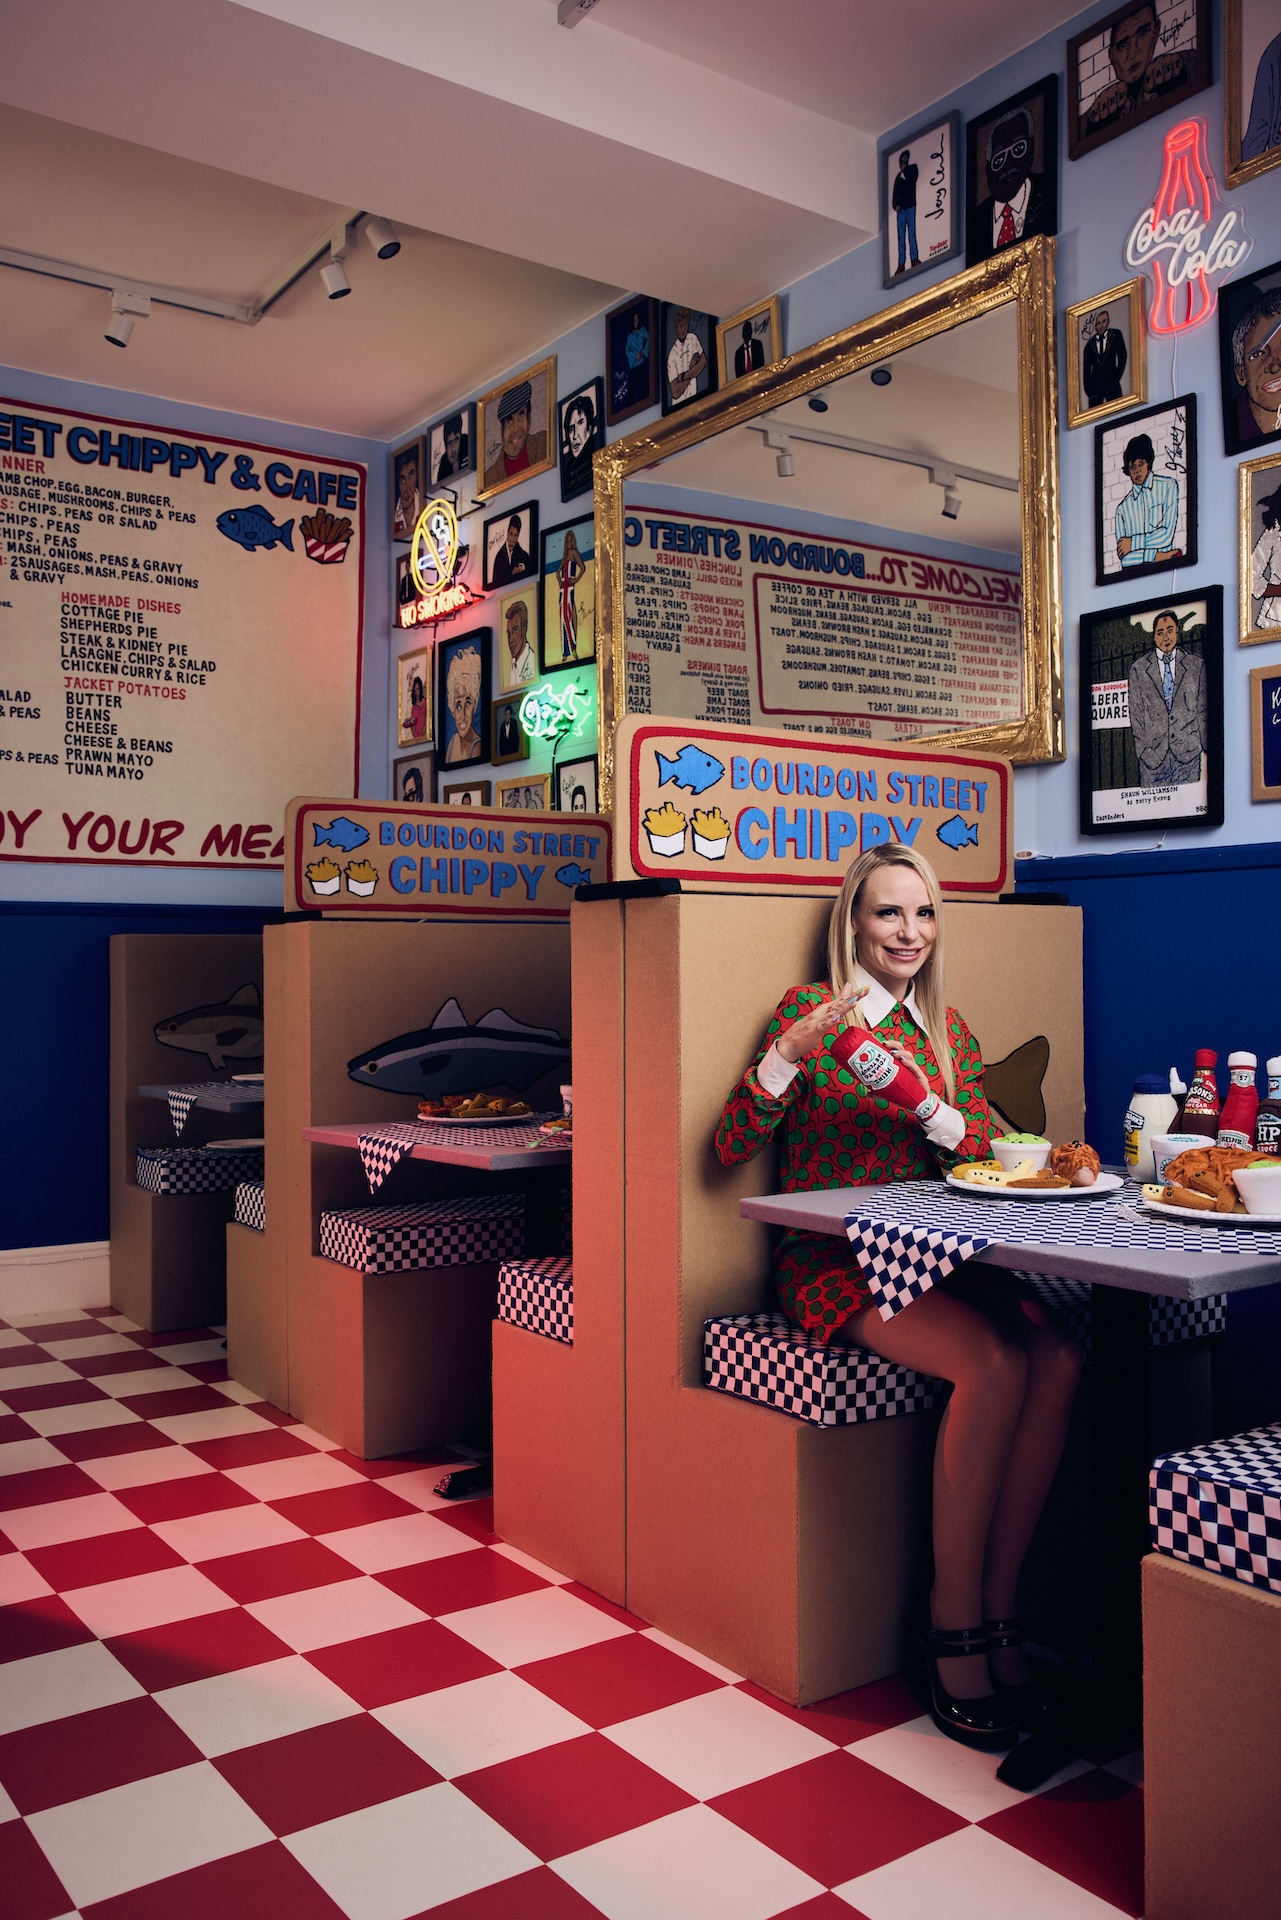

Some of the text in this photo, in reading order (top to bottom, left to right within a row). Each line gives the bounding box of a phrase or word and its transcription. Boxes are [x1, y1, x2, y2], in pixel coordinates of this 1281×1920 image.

[1126, 208, 1200, 266] Coca
[1168, 211, 1247, 287] Cola
[67, 426, 229, 486] CHIPPY
[230, 453, 262, 493] &
[265, 462, 359, 511] CAFE
[65, 507, 93, 521] PEAS
[98, 514, 114, 525] OR
[119, 517, 157, 531] SALAD
[120, 504, 152, 518] CHIPS
[155, 509, 163, 519] &
[169, 511, 196, 523] PEAS
[47, 519, 80, 534] PEAS
[44, 534, 77, 548] PEAS
[100, 554, 128, 567] PEAS
[131, 558, 140, 569] &
[143, 560, 182, 574] GRAVY
[10, 569, 65, 585] & GRAVY
[156, 574, 199, 589] ONIONS
[61, 604, 144, 624] COTTAGE PIE
[137, 598, 181, 615] DISHES
[401, 585, 467, 628] NO SMOKING
[60, 617, 157, 639] SHEPHERDS PIE
[60, 632, 188, 656] STEAK & KIDNEY PIE
[128, 652, 164, 668] CHIPS
[168, 657, 176, 668] &
[179, 659, 216, 672] SALAD
[61, 659, 206, 685] CHICKEN CURRY & RICE
[64, 676, 186, 700] JACKET POTATOES
[66, 691, 122, 709] BUTTER
[9, 706, 41, 719] PEAS
[66, 706, 111, 722] BEANS
[65, 720, 118, 736] CHEESE
[64, 734, 173, 753] CHEESE & BEANS
[15, 751, 24, 762] &
[28, 752, 59, 765] PEAS
[66, 748, 153, 767] PRAWN MAYO
[65, 762, 144, 780] TUNA MAYO
[730, 755, 989, 814] BOURDON STREET
[1121, 787, 1178, 799] SHAUN WILLIAMSON
[62, 810, 185, 857] YOUR
[379, 821, 601, 862] BOURDON STREET
[734, 806, 923, 863] CHIPPY
[389, 856, 545, 899] CHIPPY
[874, 1068, 892, 1085] HEINZ
[1257, 1126, 1281, 1141] HP
